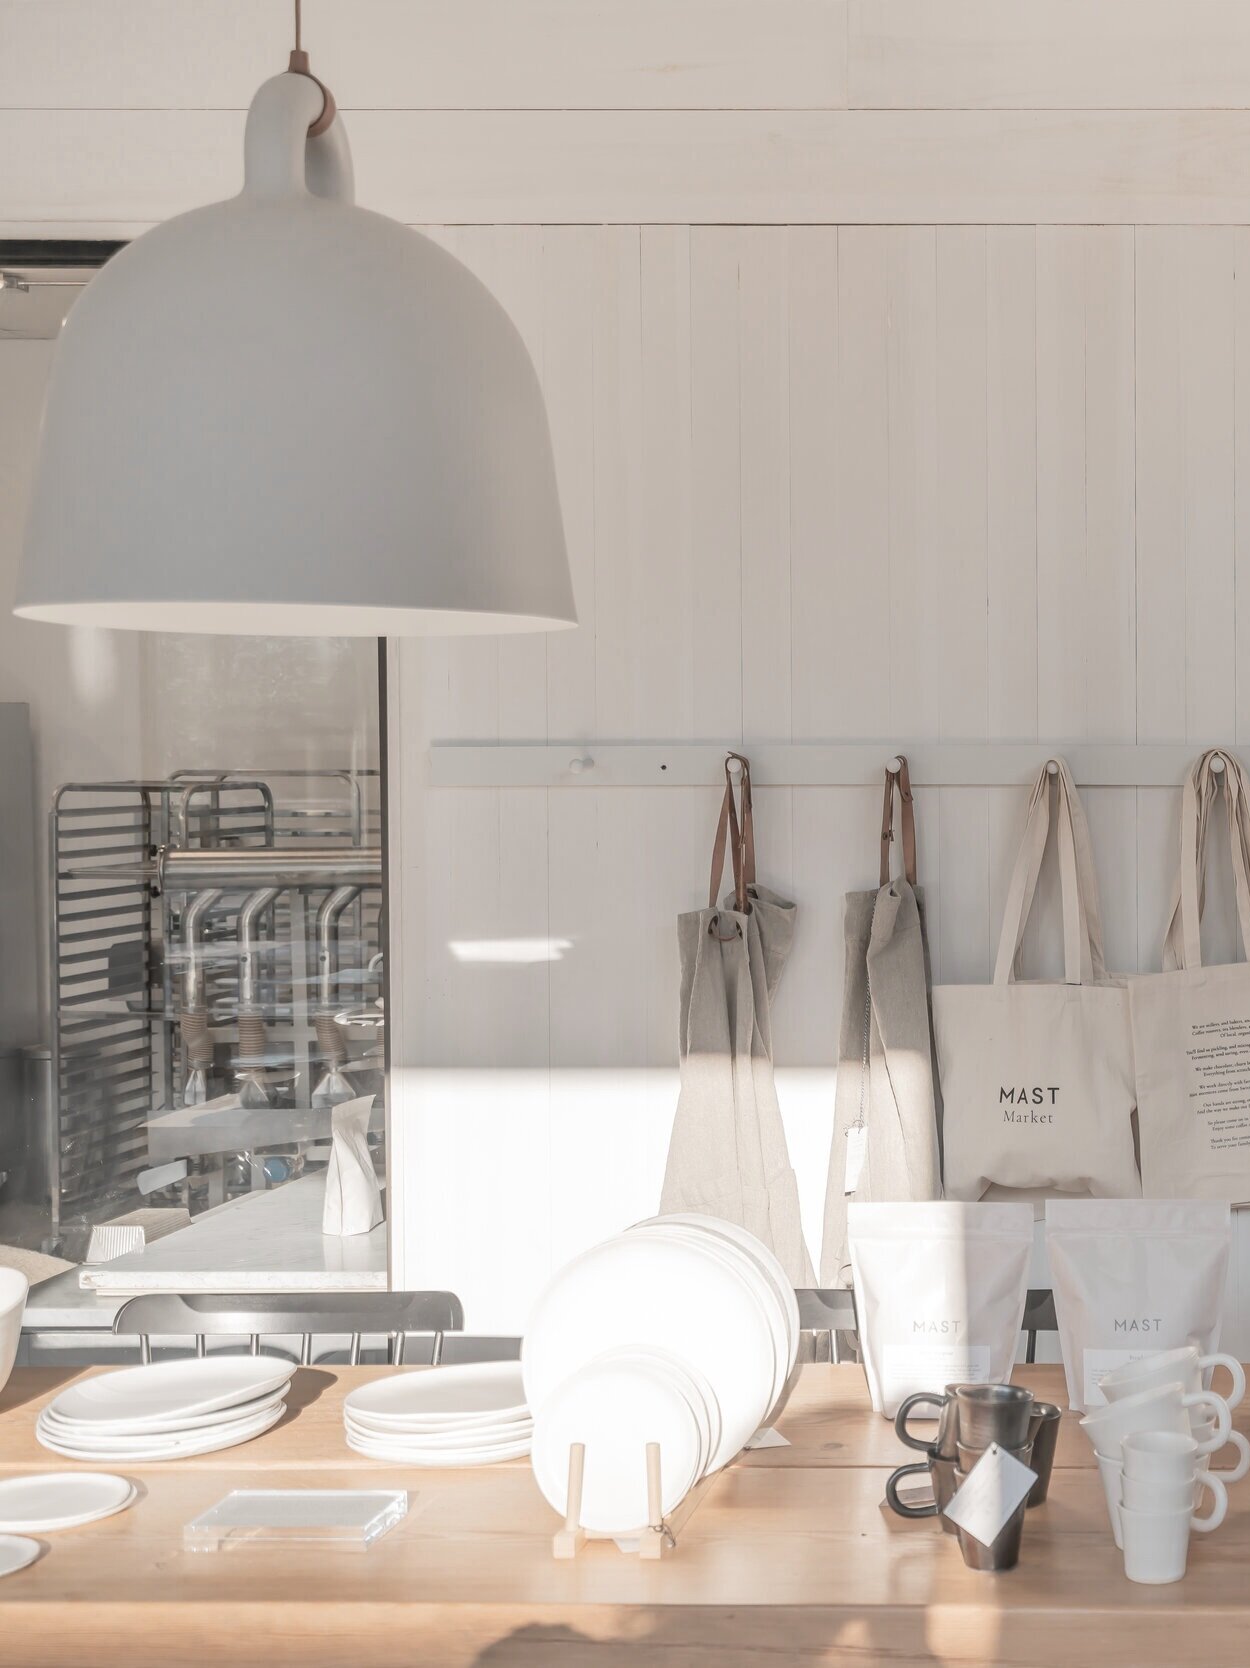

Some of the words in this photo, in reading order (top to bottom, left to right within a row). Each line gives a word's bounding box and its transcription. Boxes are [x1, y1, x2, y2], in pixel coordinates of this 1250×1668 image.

[999, 1086, 1060, 1105] MAST
[1003, 1110, 1053, 1124] Market
[913, 1320, 961, 1334] MAST
[1114, 1319, 1162, 1333] MAST
